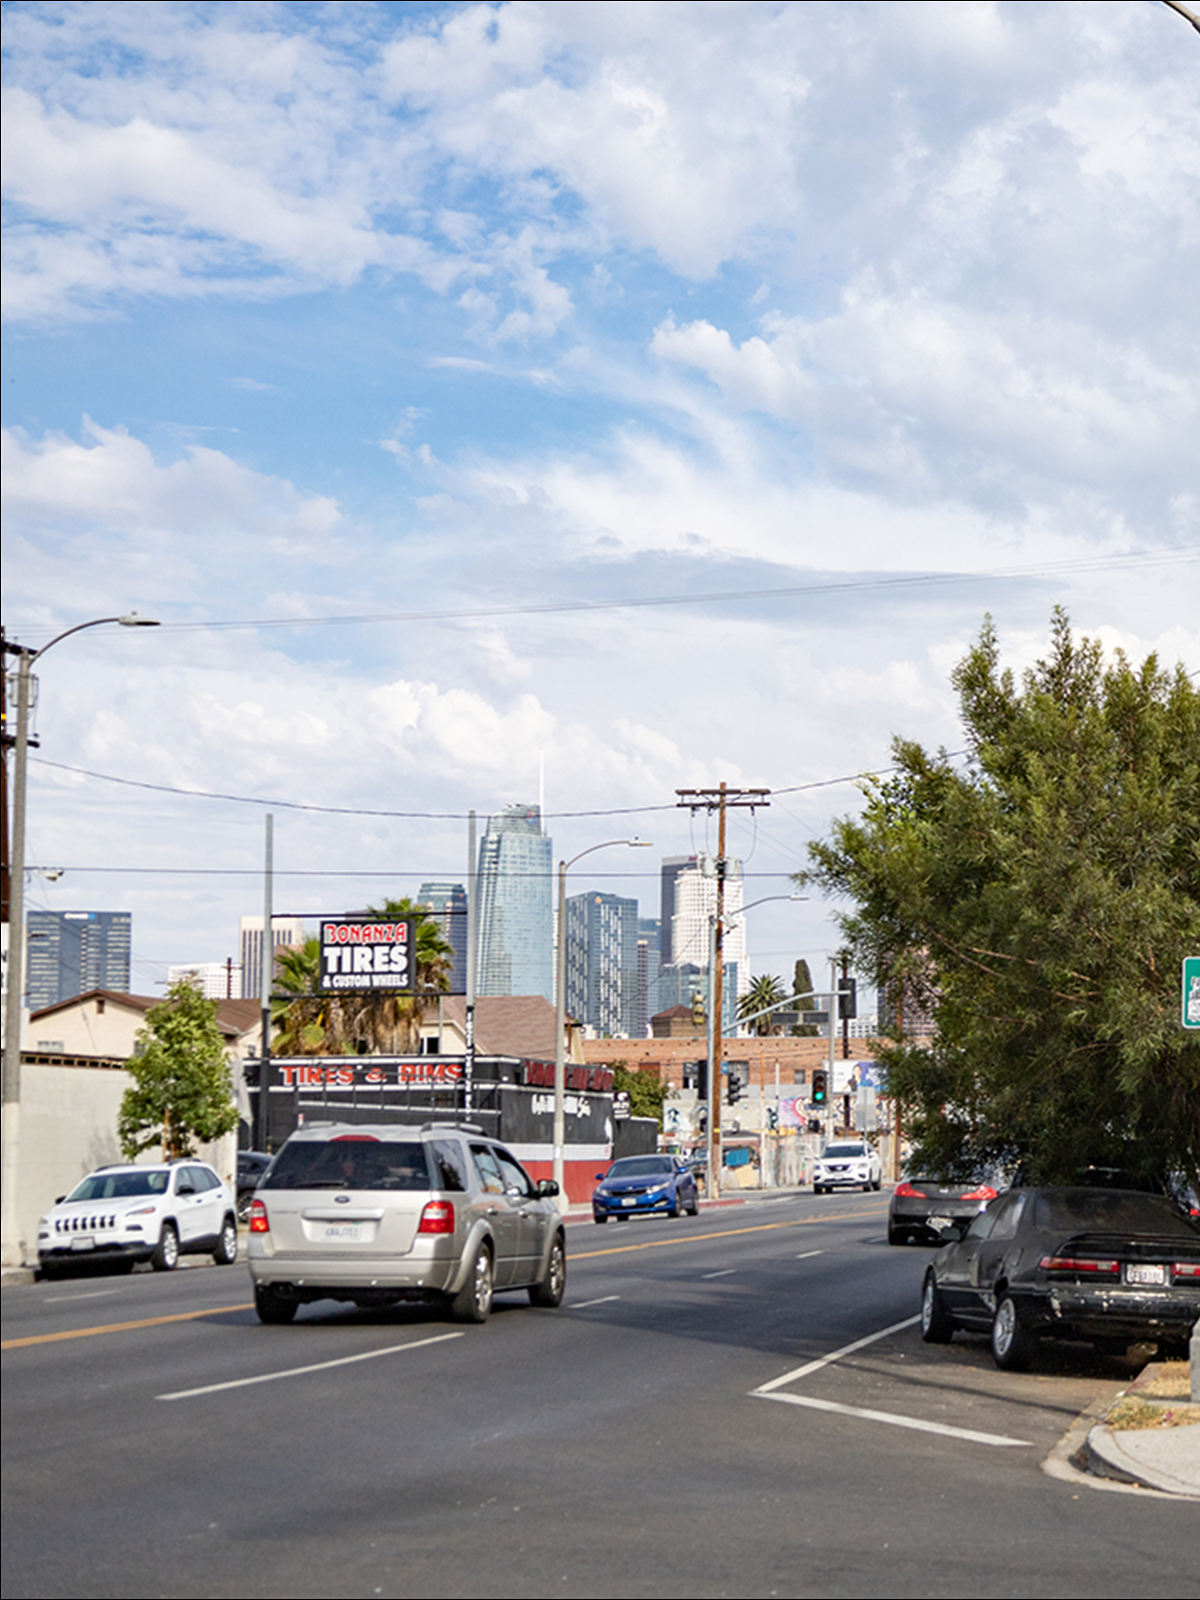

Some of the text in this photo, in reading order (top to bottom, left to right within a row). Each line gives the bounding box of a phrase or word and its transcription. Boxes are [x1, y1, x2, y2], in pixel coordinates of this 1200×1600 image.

[323, 922, 408, 945] BONANZA
[323, 945, 409, 973] TIRES
[322, 974, 408, 988] & CUSTOM WHEELS
[279, 1063, 463, 1087] TIRES & RIMS
